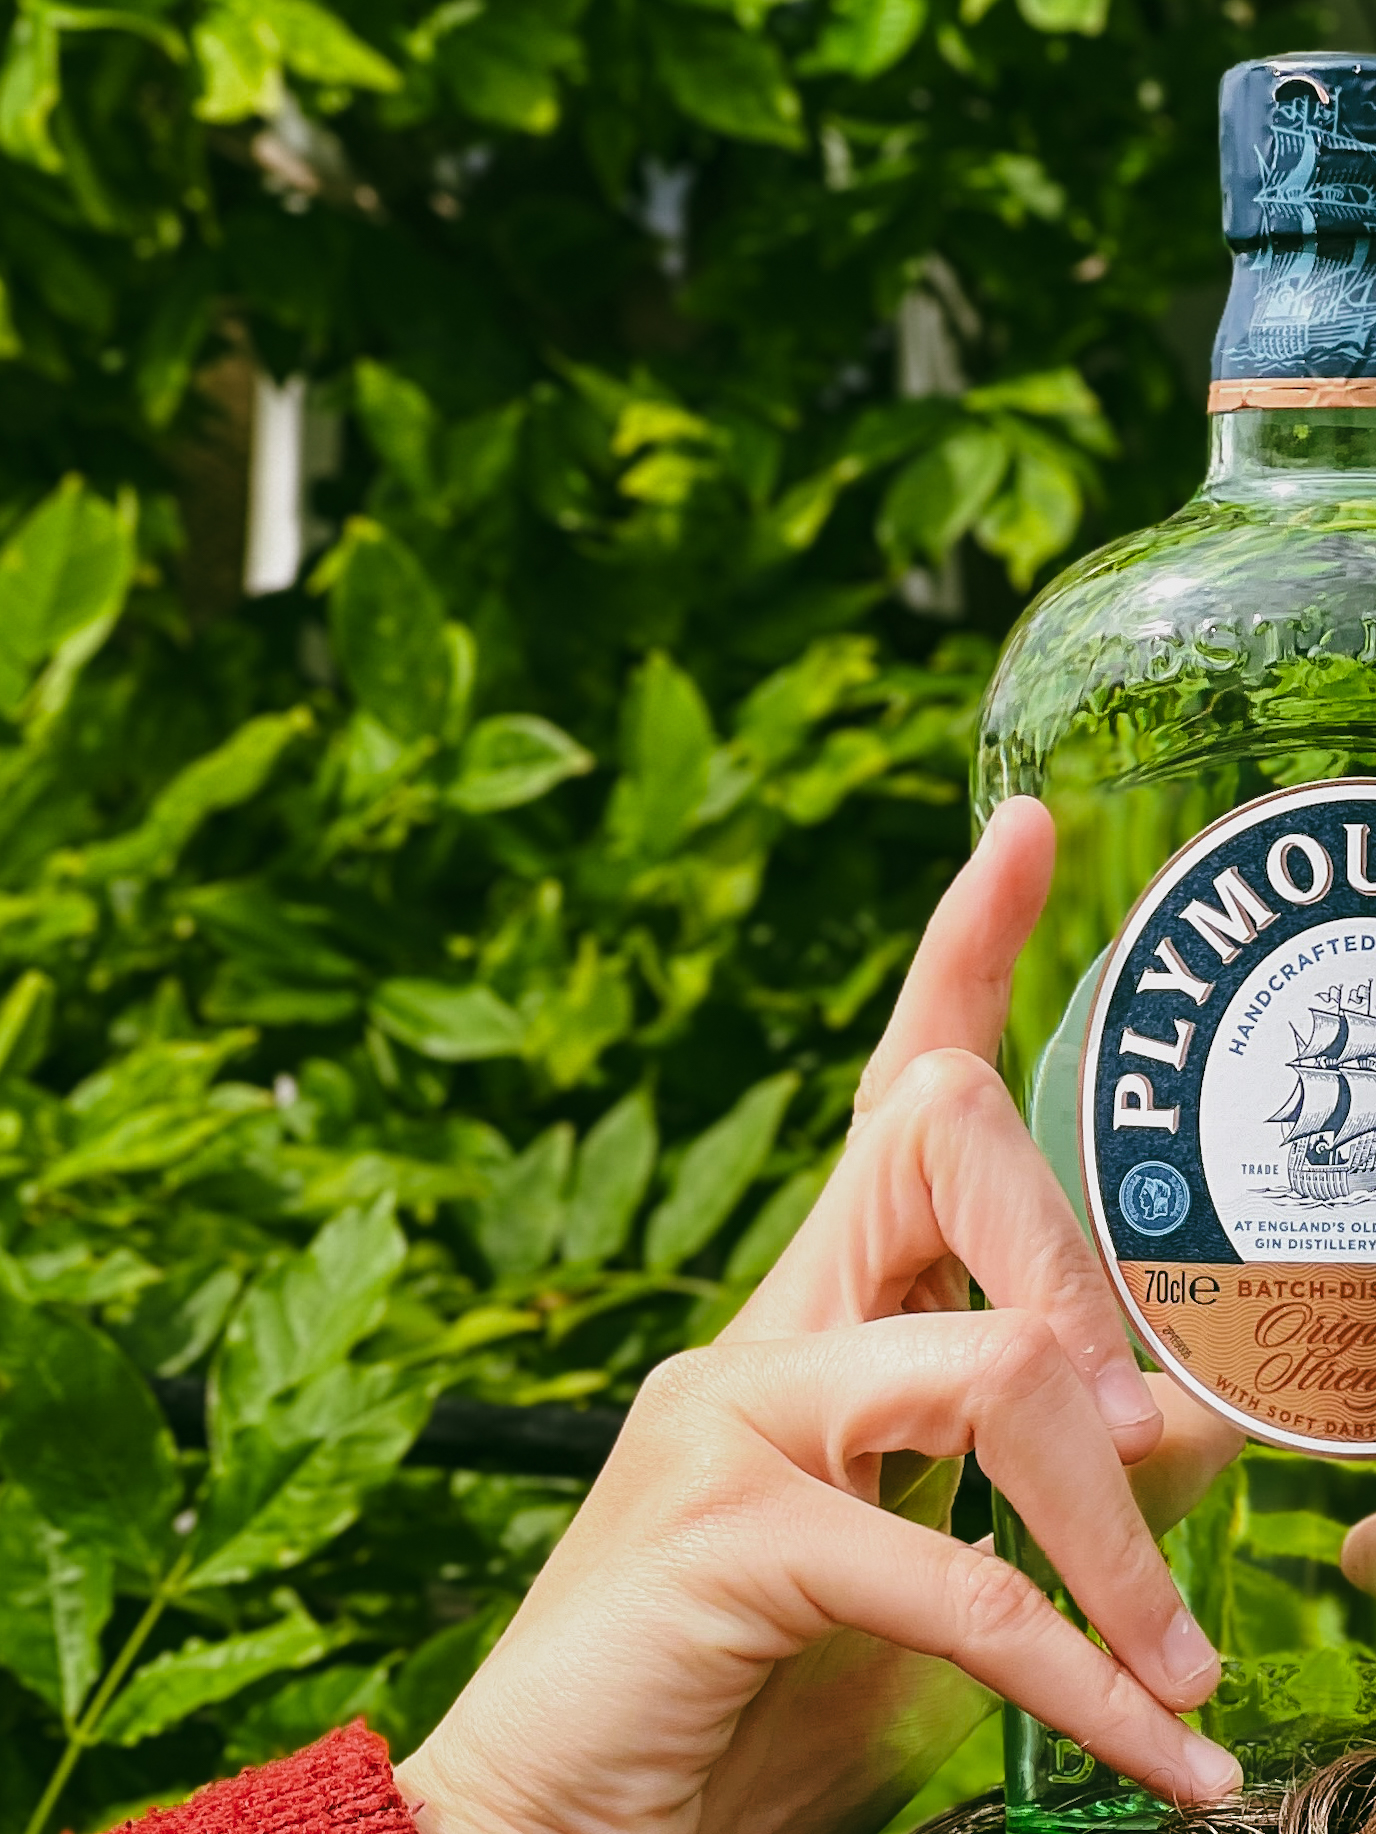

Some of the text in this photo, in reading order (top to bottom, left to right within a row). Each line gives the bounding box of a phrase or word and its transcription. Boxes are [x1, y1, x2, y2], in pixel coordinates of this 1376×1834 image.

[1228, 934, 1376, 1056] HANDCRAFTED
[1240, 1163, 1279, 1176] TRADE
[1233, 1220, 1252, 1232] AT
[1257, 1220, 1346, 1234] ENGLAND'S
[1254, 1237, 1282, 1250] GIN
[1215, 1373, 1261, 1411] WITH
[1265, 1404, 1318, 1431] SOFT
